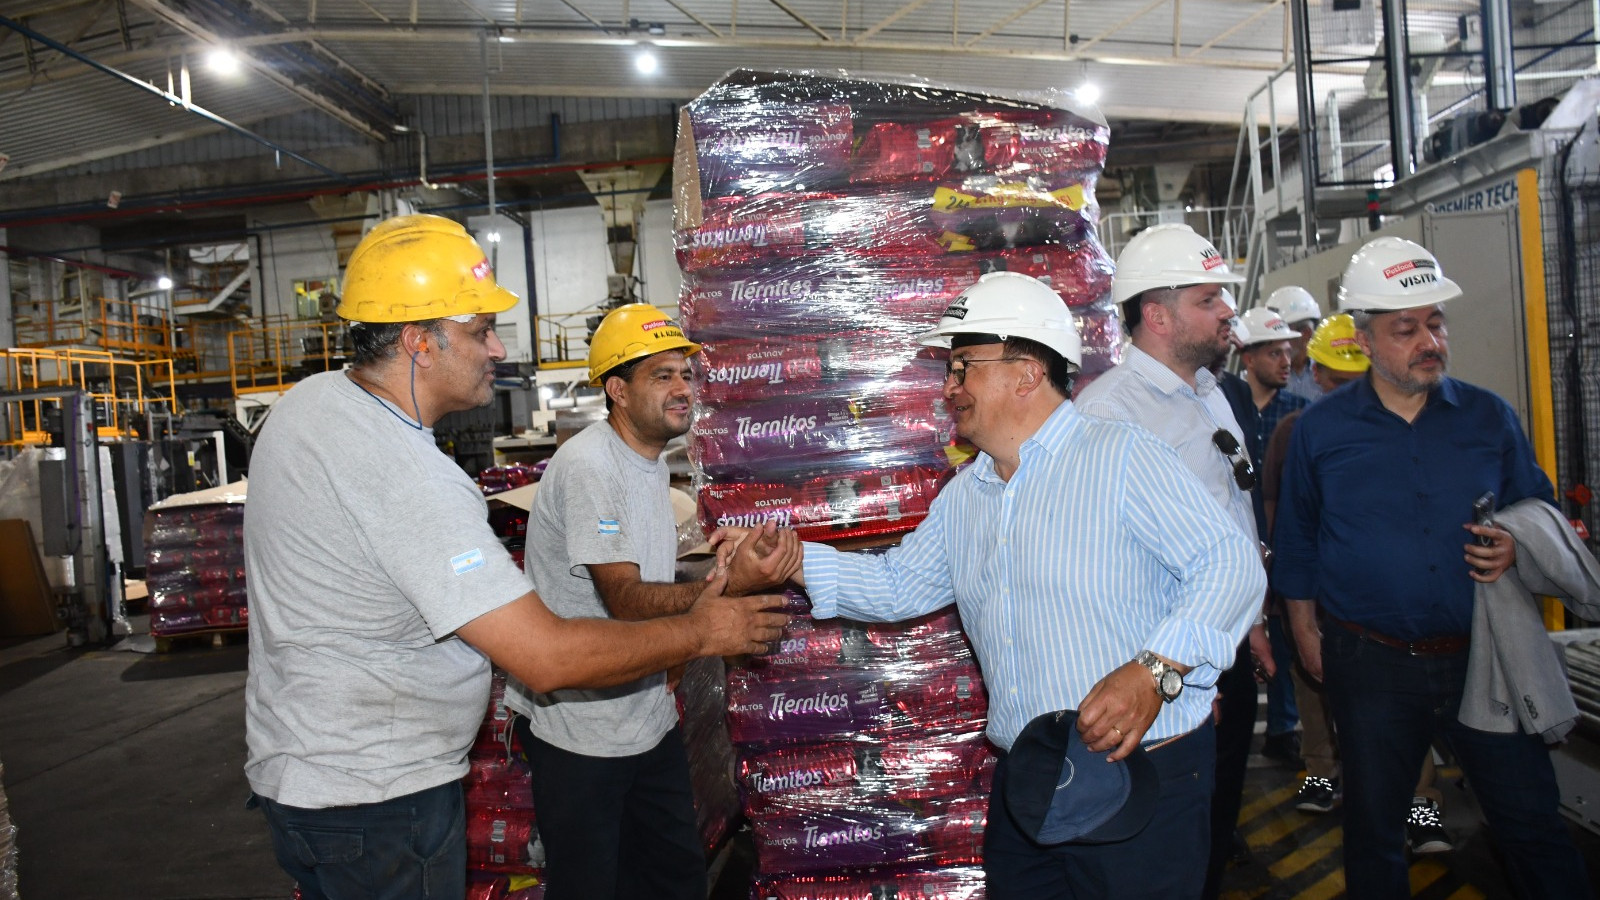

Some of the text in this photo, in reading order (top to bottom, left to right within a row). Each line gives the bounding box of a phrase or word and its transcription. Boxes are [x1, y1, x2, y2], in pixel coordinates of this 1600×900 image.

[808, 132, 848, 143] ADULTOS
[1018, 146, 1055, 154] ADULTOS
[692, 224, 769, 248] Tiernitos
[1400, 273, 1437, 288] VISITA
[729, 279, 812, 302] Tiernitos
[747, 349, 783, 360] ADULTOS
[707, 361, 784, 385] Tiernitos
[735, 414, 817, 440] Tiernitos
[754, 497, 792, 507] ADULTOS
[773, 656, 809, 666] ADULTOS
[770, 691, 848, 714] Tiernitos
[751, 769, 823, 793] Tiernitos
[763, 838, 798, 846] ADULTOS
[803, 824, 882, 848] Tiernitos
